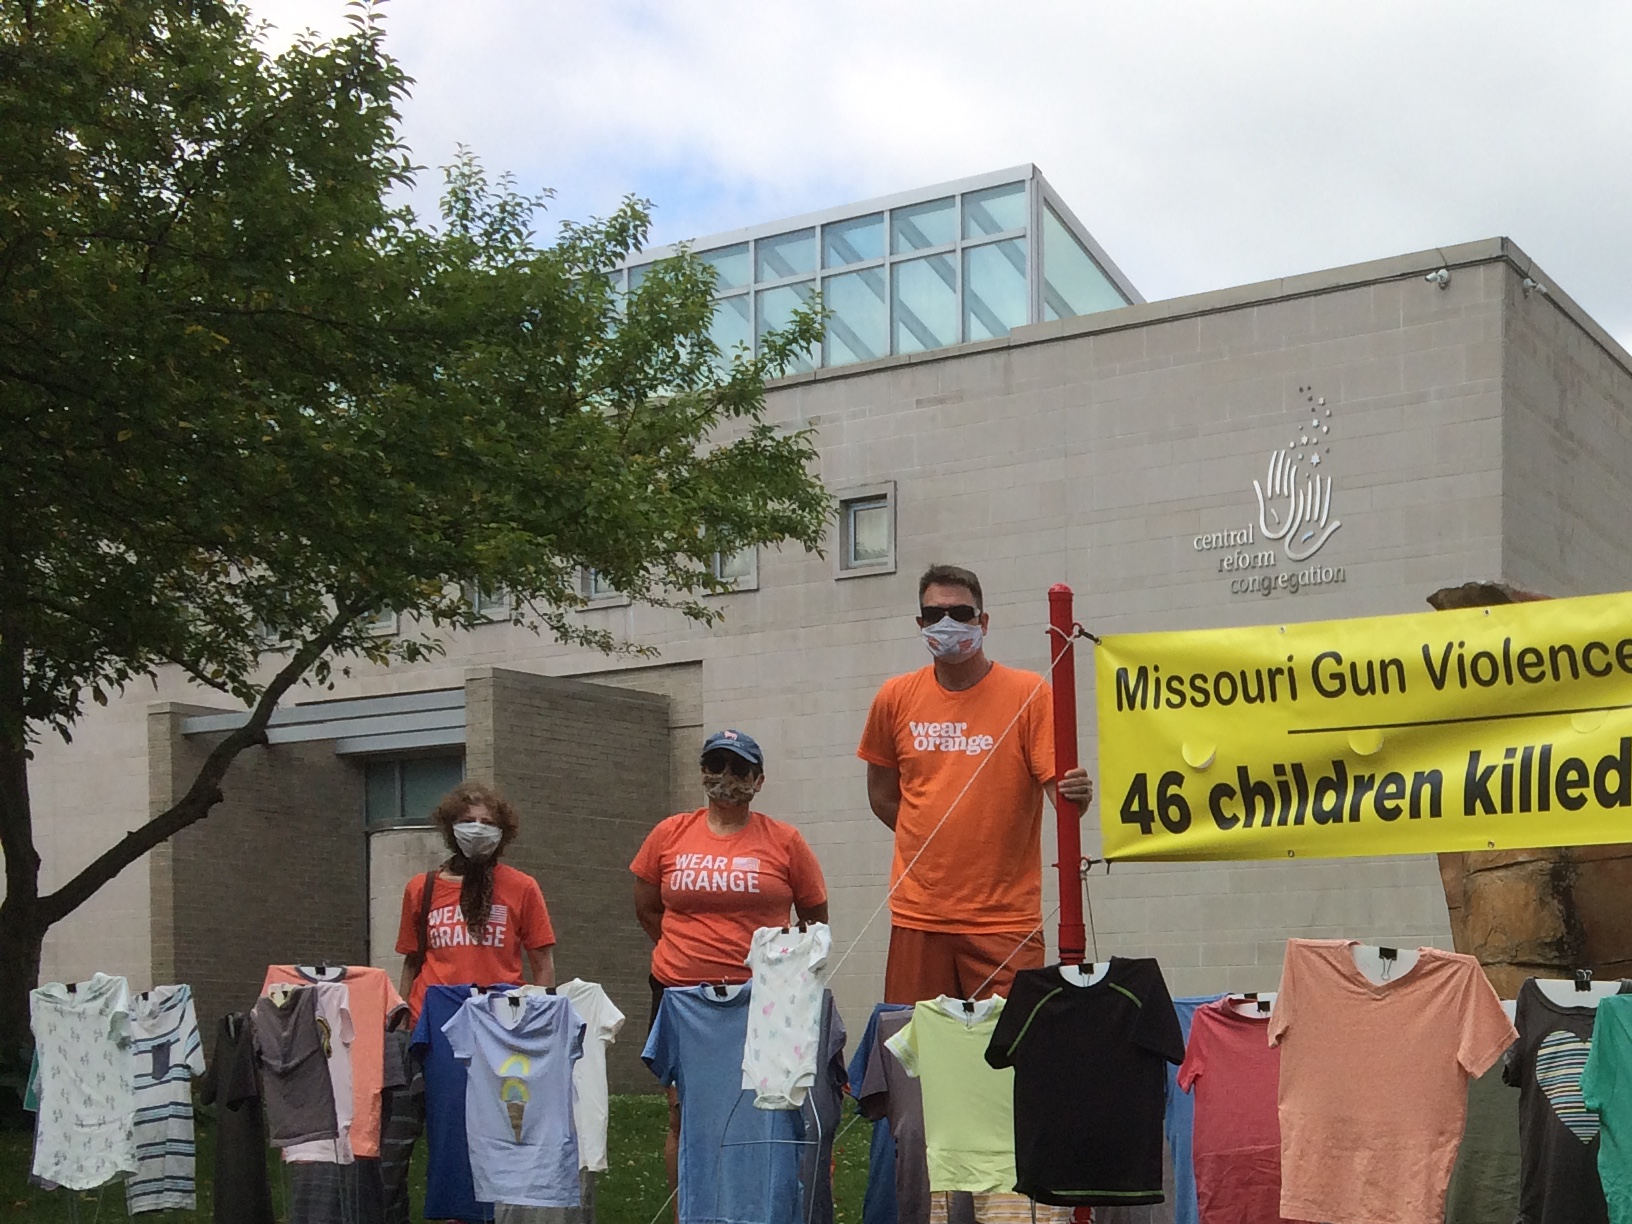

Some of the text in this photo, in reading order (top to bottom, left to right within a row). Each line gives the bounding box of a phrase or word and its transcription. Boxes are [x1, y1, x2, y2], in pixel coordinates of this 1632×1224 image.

[1193, 523, 1254, 551] central
[1218, 549, 1276, 573] reform
[1231, 564, 1346, 595] congregation
[1115, 656, 1299, 712] Missouri
[1311, 650, 1407, 699] Gun
[909, 721, 967, 737] wear
[914, 734, 994, 756] orange
[1119, 770, 1192, 836] 46
[1208, 759, 1443, 831] children
[1462, 736, 1632, 817] killed
[676, 854, 728, 870] WEAR
[670, 870, 760, 893] ORANGE
[428, 905, 464, 926] WEA
